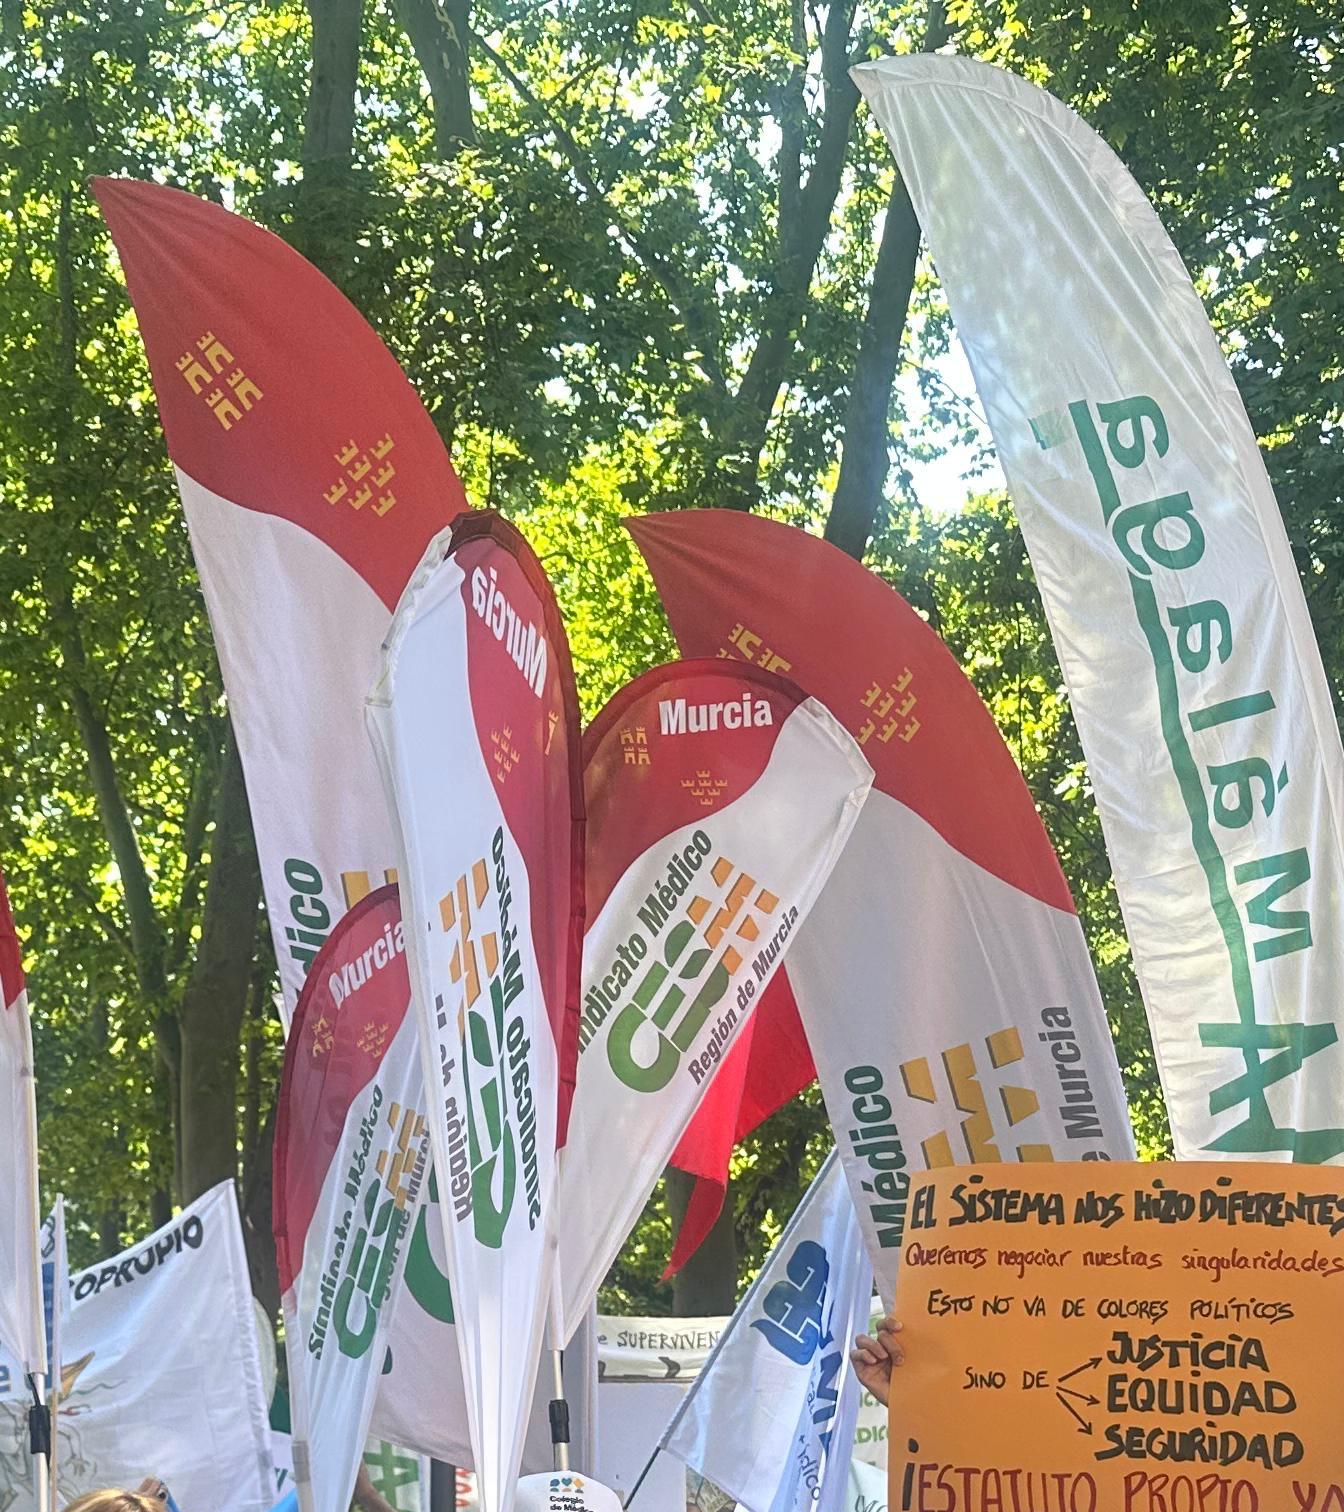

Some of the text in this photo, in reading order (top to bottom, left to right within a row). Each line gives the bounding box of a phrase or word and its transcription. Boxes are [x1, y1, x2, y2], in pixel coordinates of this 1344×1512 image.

[659, 693, 773, 735] Murcia
[284, 858, 332, 978] dico
[578, 829, 712, 1055] ndicato Médico
[687, 905, 798, 1086] Región de Murcia
[1038, 1007, 1103, 1139] Murcia
[844, 1065, 911, 1248] Médico
[1073, 1191, 1126, 1229] NOS
[308, 1210, 352, 1360] Sindicato
[905, 1243, 987, 1268] Queremos
[997, 1248, 1070, 1279] negociar
[1082, 1246, 1163, 1269] nuestras
[982, 1296, 1015, 1316] NO
[1023, 1296, 1047, 1317] VA
[1062, 1298, 1087, 1318] DE
[1096, 1298, 1170, 1325] COLORES
[1022, 1370, 1050, 1390] DE
